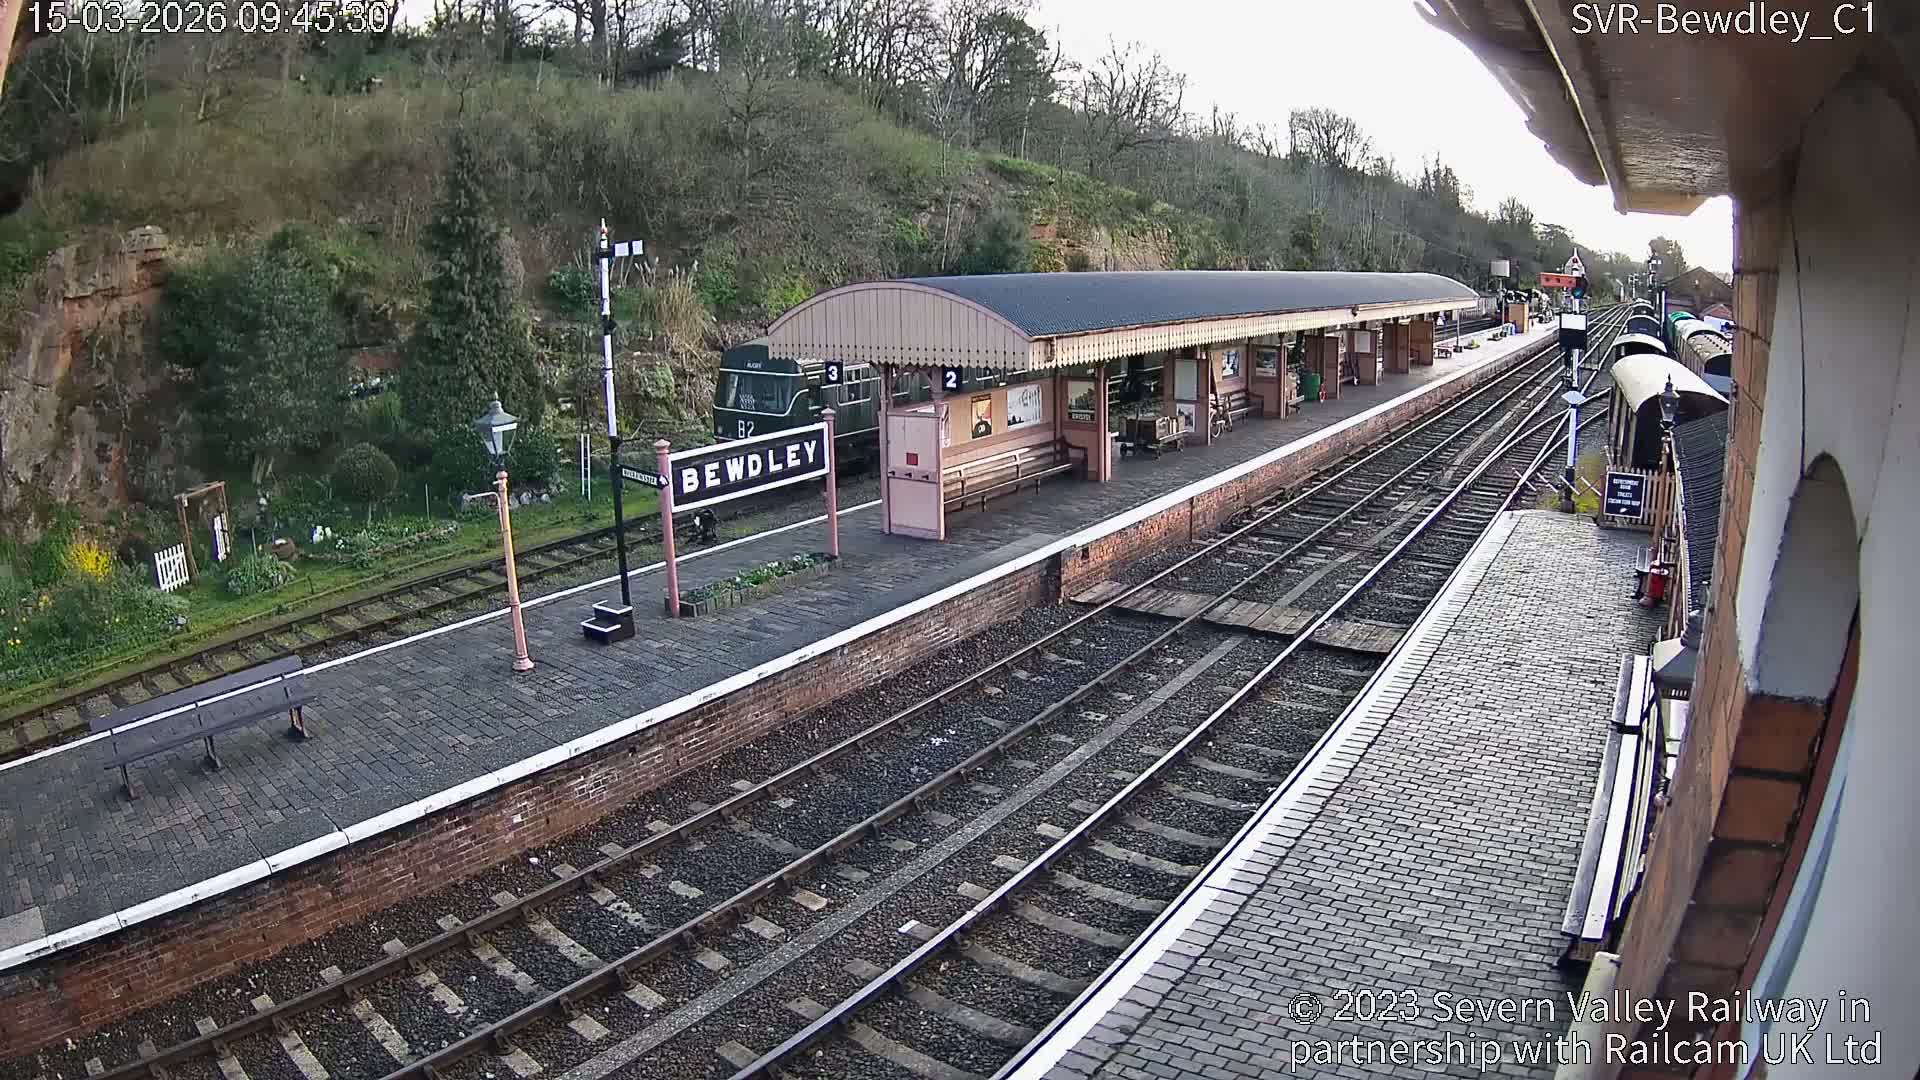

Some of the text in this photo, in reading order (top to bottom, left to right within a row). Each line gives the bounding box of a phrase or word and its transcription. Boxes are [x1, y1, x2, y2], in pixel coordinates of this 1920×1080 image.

[828, 365, 838, 381] 3
[946, 371, 957, 388] 2
[738, 420, 755, 438] B2
[681, 439, 817, 494] BEWDLEY
